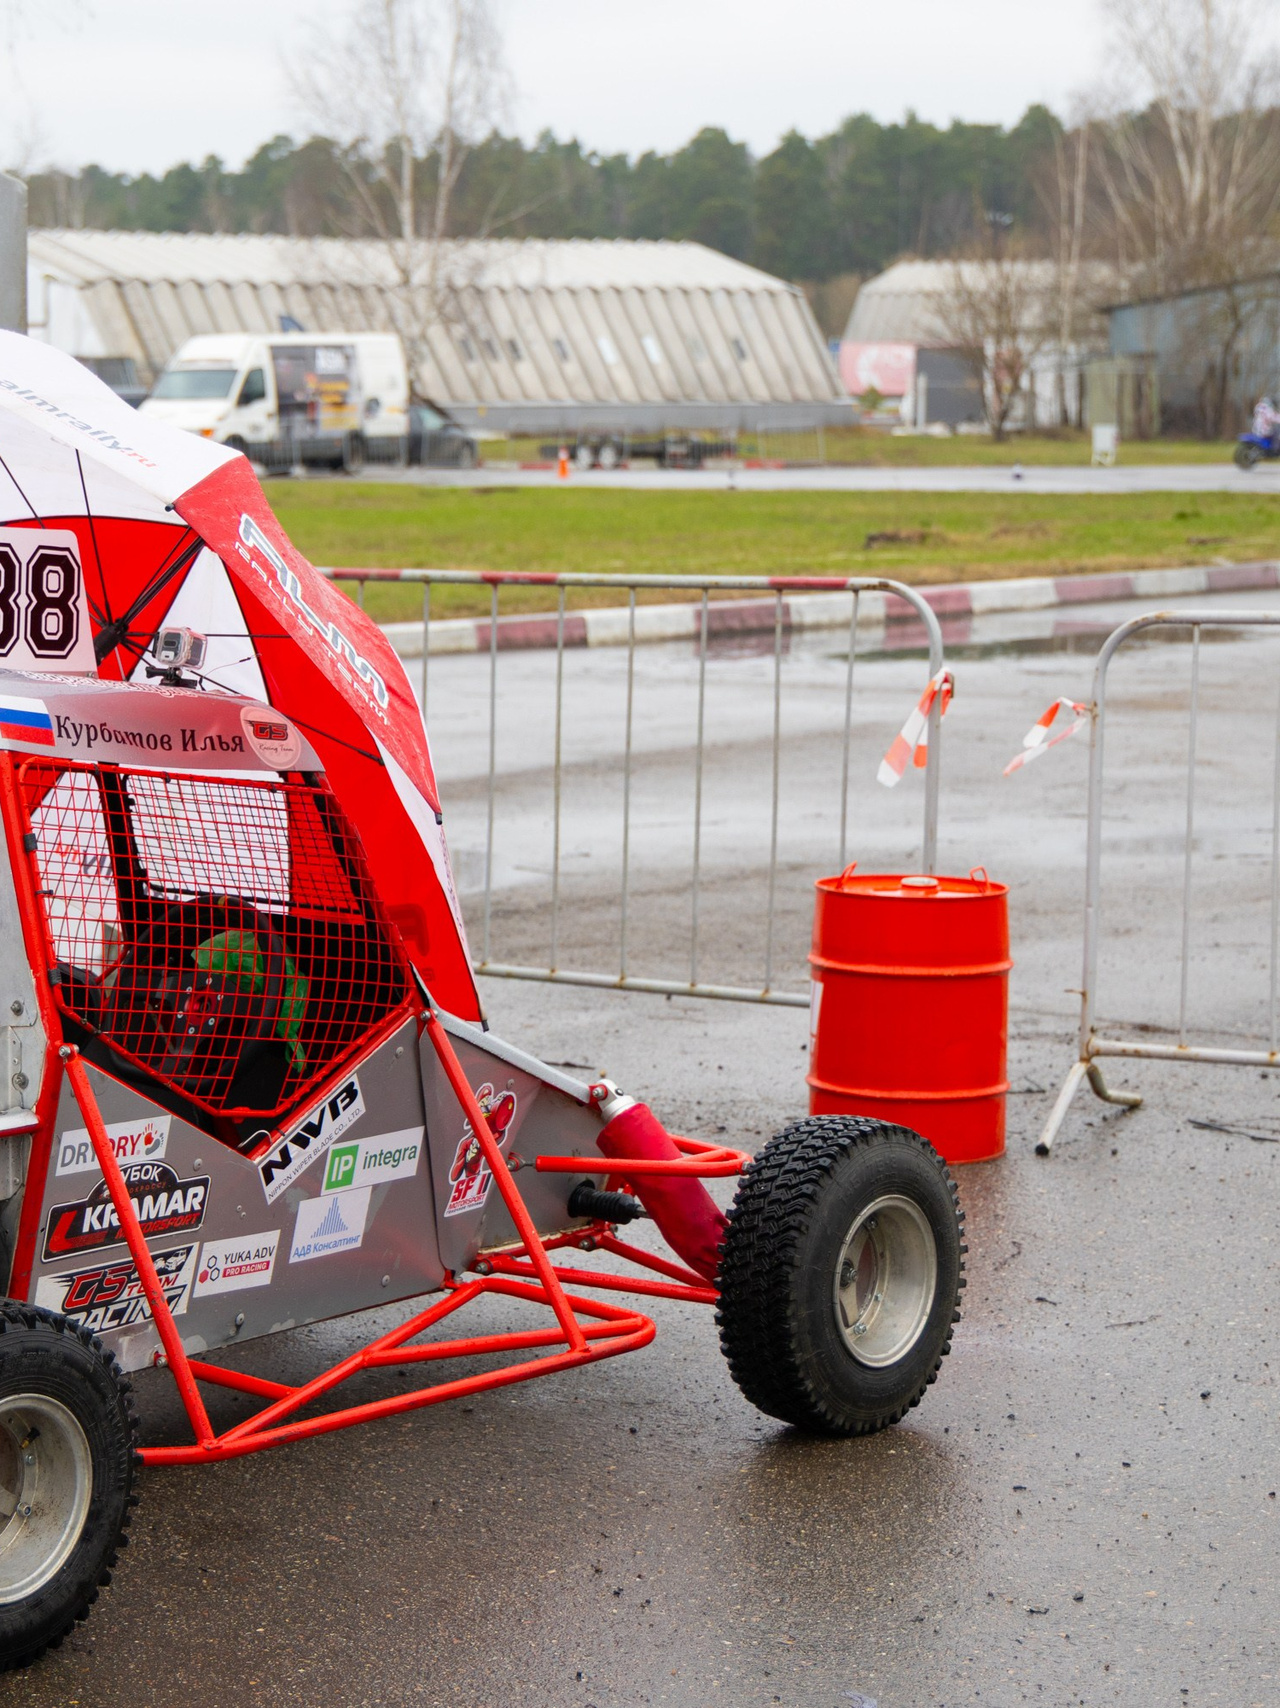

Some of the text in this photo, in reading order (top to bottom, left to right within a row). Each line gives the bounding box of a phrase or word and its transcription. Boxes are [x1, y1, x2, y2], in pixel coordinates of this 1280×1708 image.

[234, 541, 313, 637] RALLY
[54, 714, 245, 753] Курбатов Илья
[261, 1080, 359, 1187] NWB
[268, 1173, 293, 1199] NIPPON
[293, 1153, 313, 1176] WIPER
[312, 1134, 334, 1156] BLADE
[363, 1145, 418, 1170] integra
[120, 1164, 163, 1182] УБОК
[114, 1212, 201, 1240] MORSPORT
[224, 1245, 276, 1265] YUKA ADV
[292, 1234, 361, 1259] АДВ Консалтинг
[225, 1261, 268, 1277] PRO RACING
